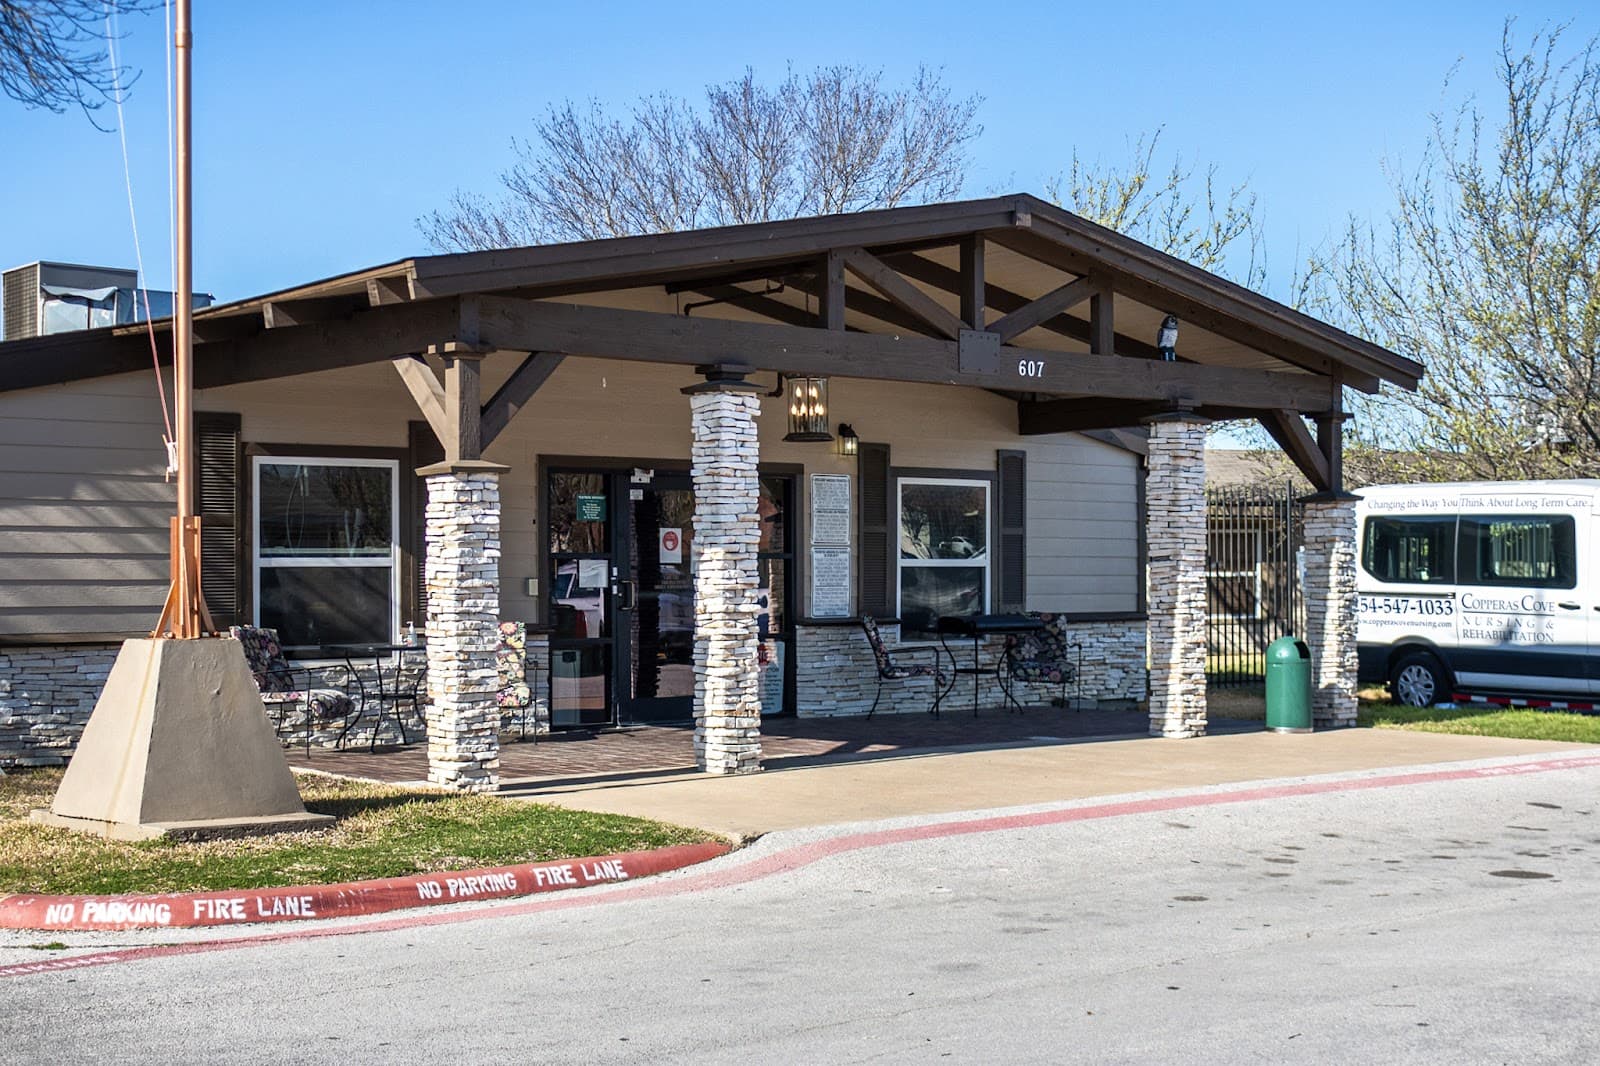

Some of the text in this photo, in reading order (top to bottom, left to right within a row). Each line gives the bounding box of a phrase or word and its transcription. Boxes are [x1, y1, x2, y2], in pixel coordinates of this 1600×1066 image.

[1018, 359, 1045, 377] 607
[1367, 498, 1406, 511] Changing
[1407, 499, 1420, 508] the
[1421, 498, 1439, 510] Way
[1442, 498, 1458, 507] You
[1460, 497, 1484, 508] Think
[1487, 497, 1514, 508] About
[1515, 497, 1538, 510] Long
[1541, 497, 1564, 508] Term
[1461, 592, 1555, 612] COPPERAS COVE
[1462, 615, 1536, 629] NURSING
[1462, 628, 1554, 643] REHABILITATION
[416, 859, 629, 900] NO PARKING FIRE LANE
[45, 902, 74, 925] NO
[81, 901, 172, 925] PARKING
[193, 897, 247, 920] FIRE
[256, 895, 317, 918] LANE
